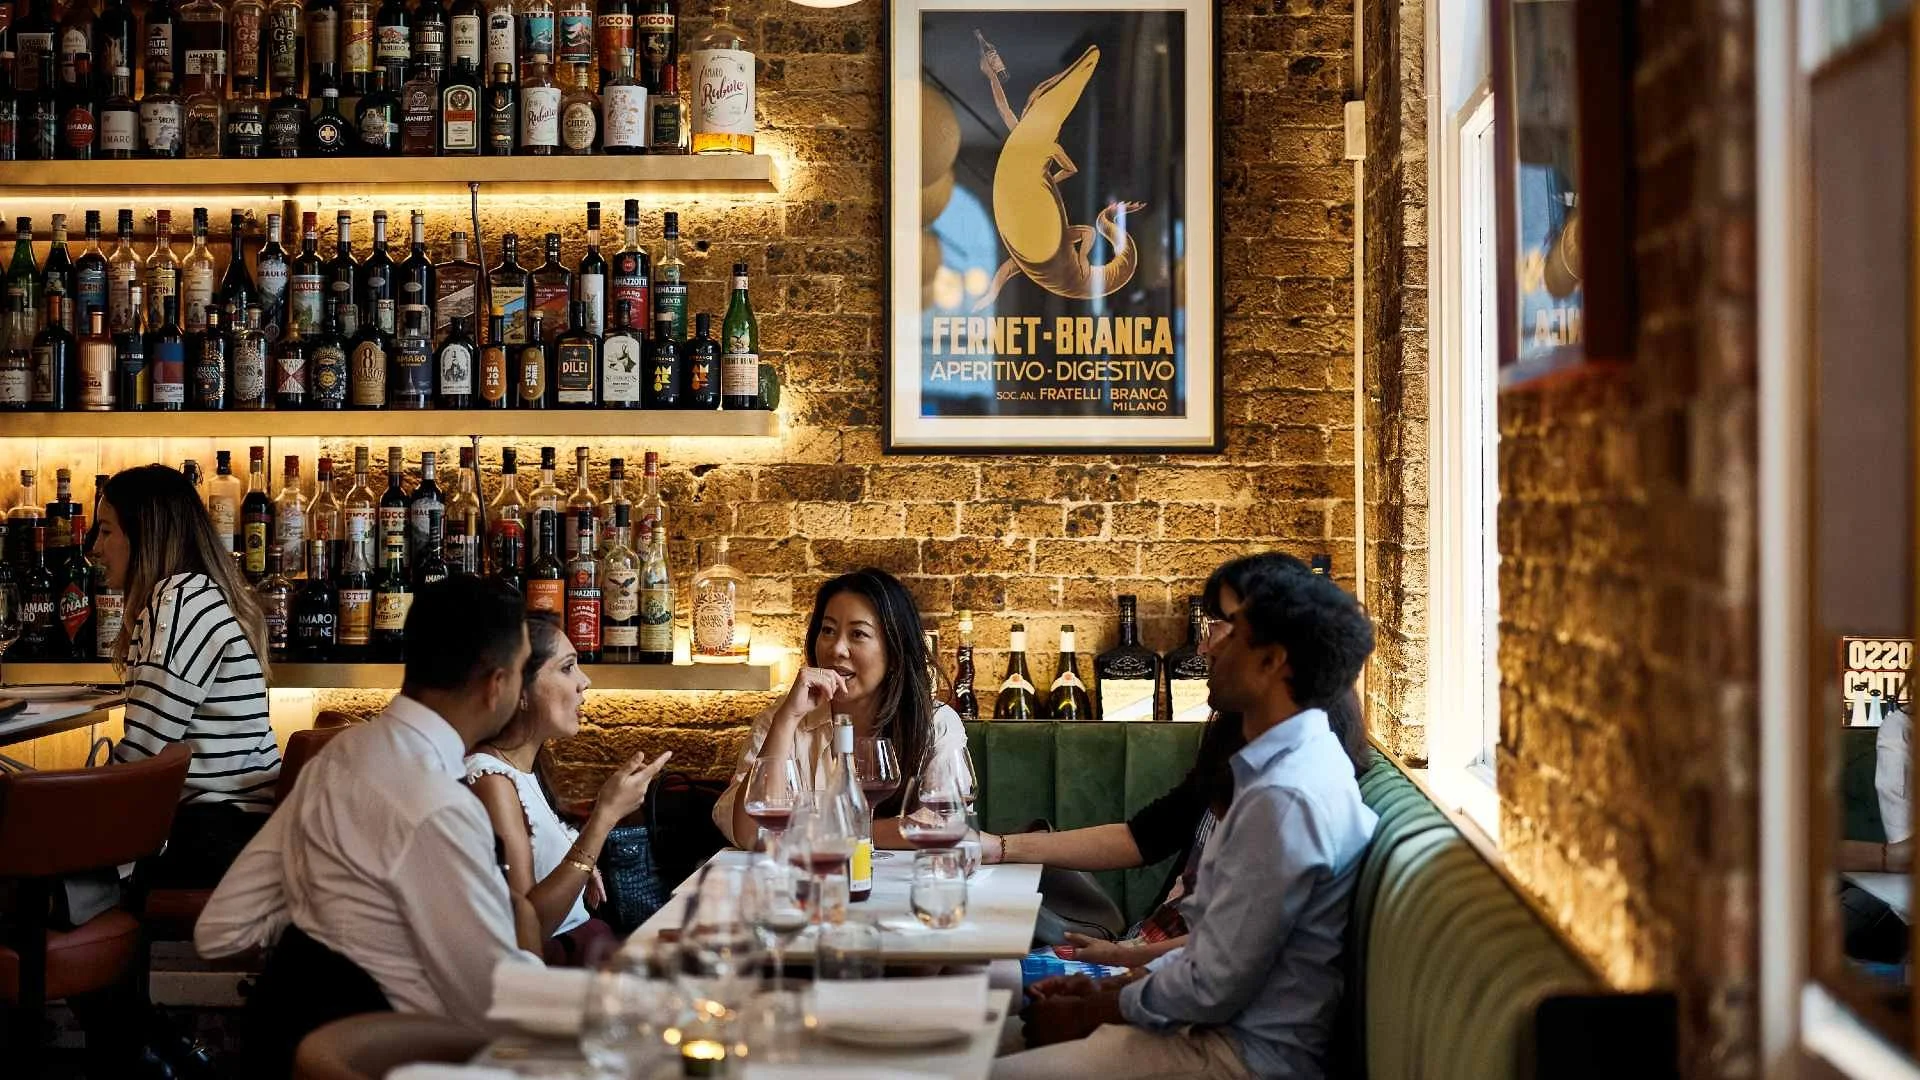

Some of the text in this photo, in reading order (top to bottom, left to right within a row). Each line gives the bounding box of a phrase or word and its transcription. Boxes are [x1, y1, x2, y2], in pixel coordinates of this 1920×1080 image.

[600, 16, 632, 26] PICON
[640, 16, 673, 26] PICON
[151, 48, 169, 56] ERDE
[562, 361, 588, 374] DILEI
[1040, 387, 1101, 400] FRATELLI
[1110, 387, 1168, 400] BRANCA
[1113, 402, 1167, 412] MILANO
[24, 601, 55, 613] AMARO
[60, 595, 89, 620] CYNAR
[298, 613, 333, 625] AMARO
